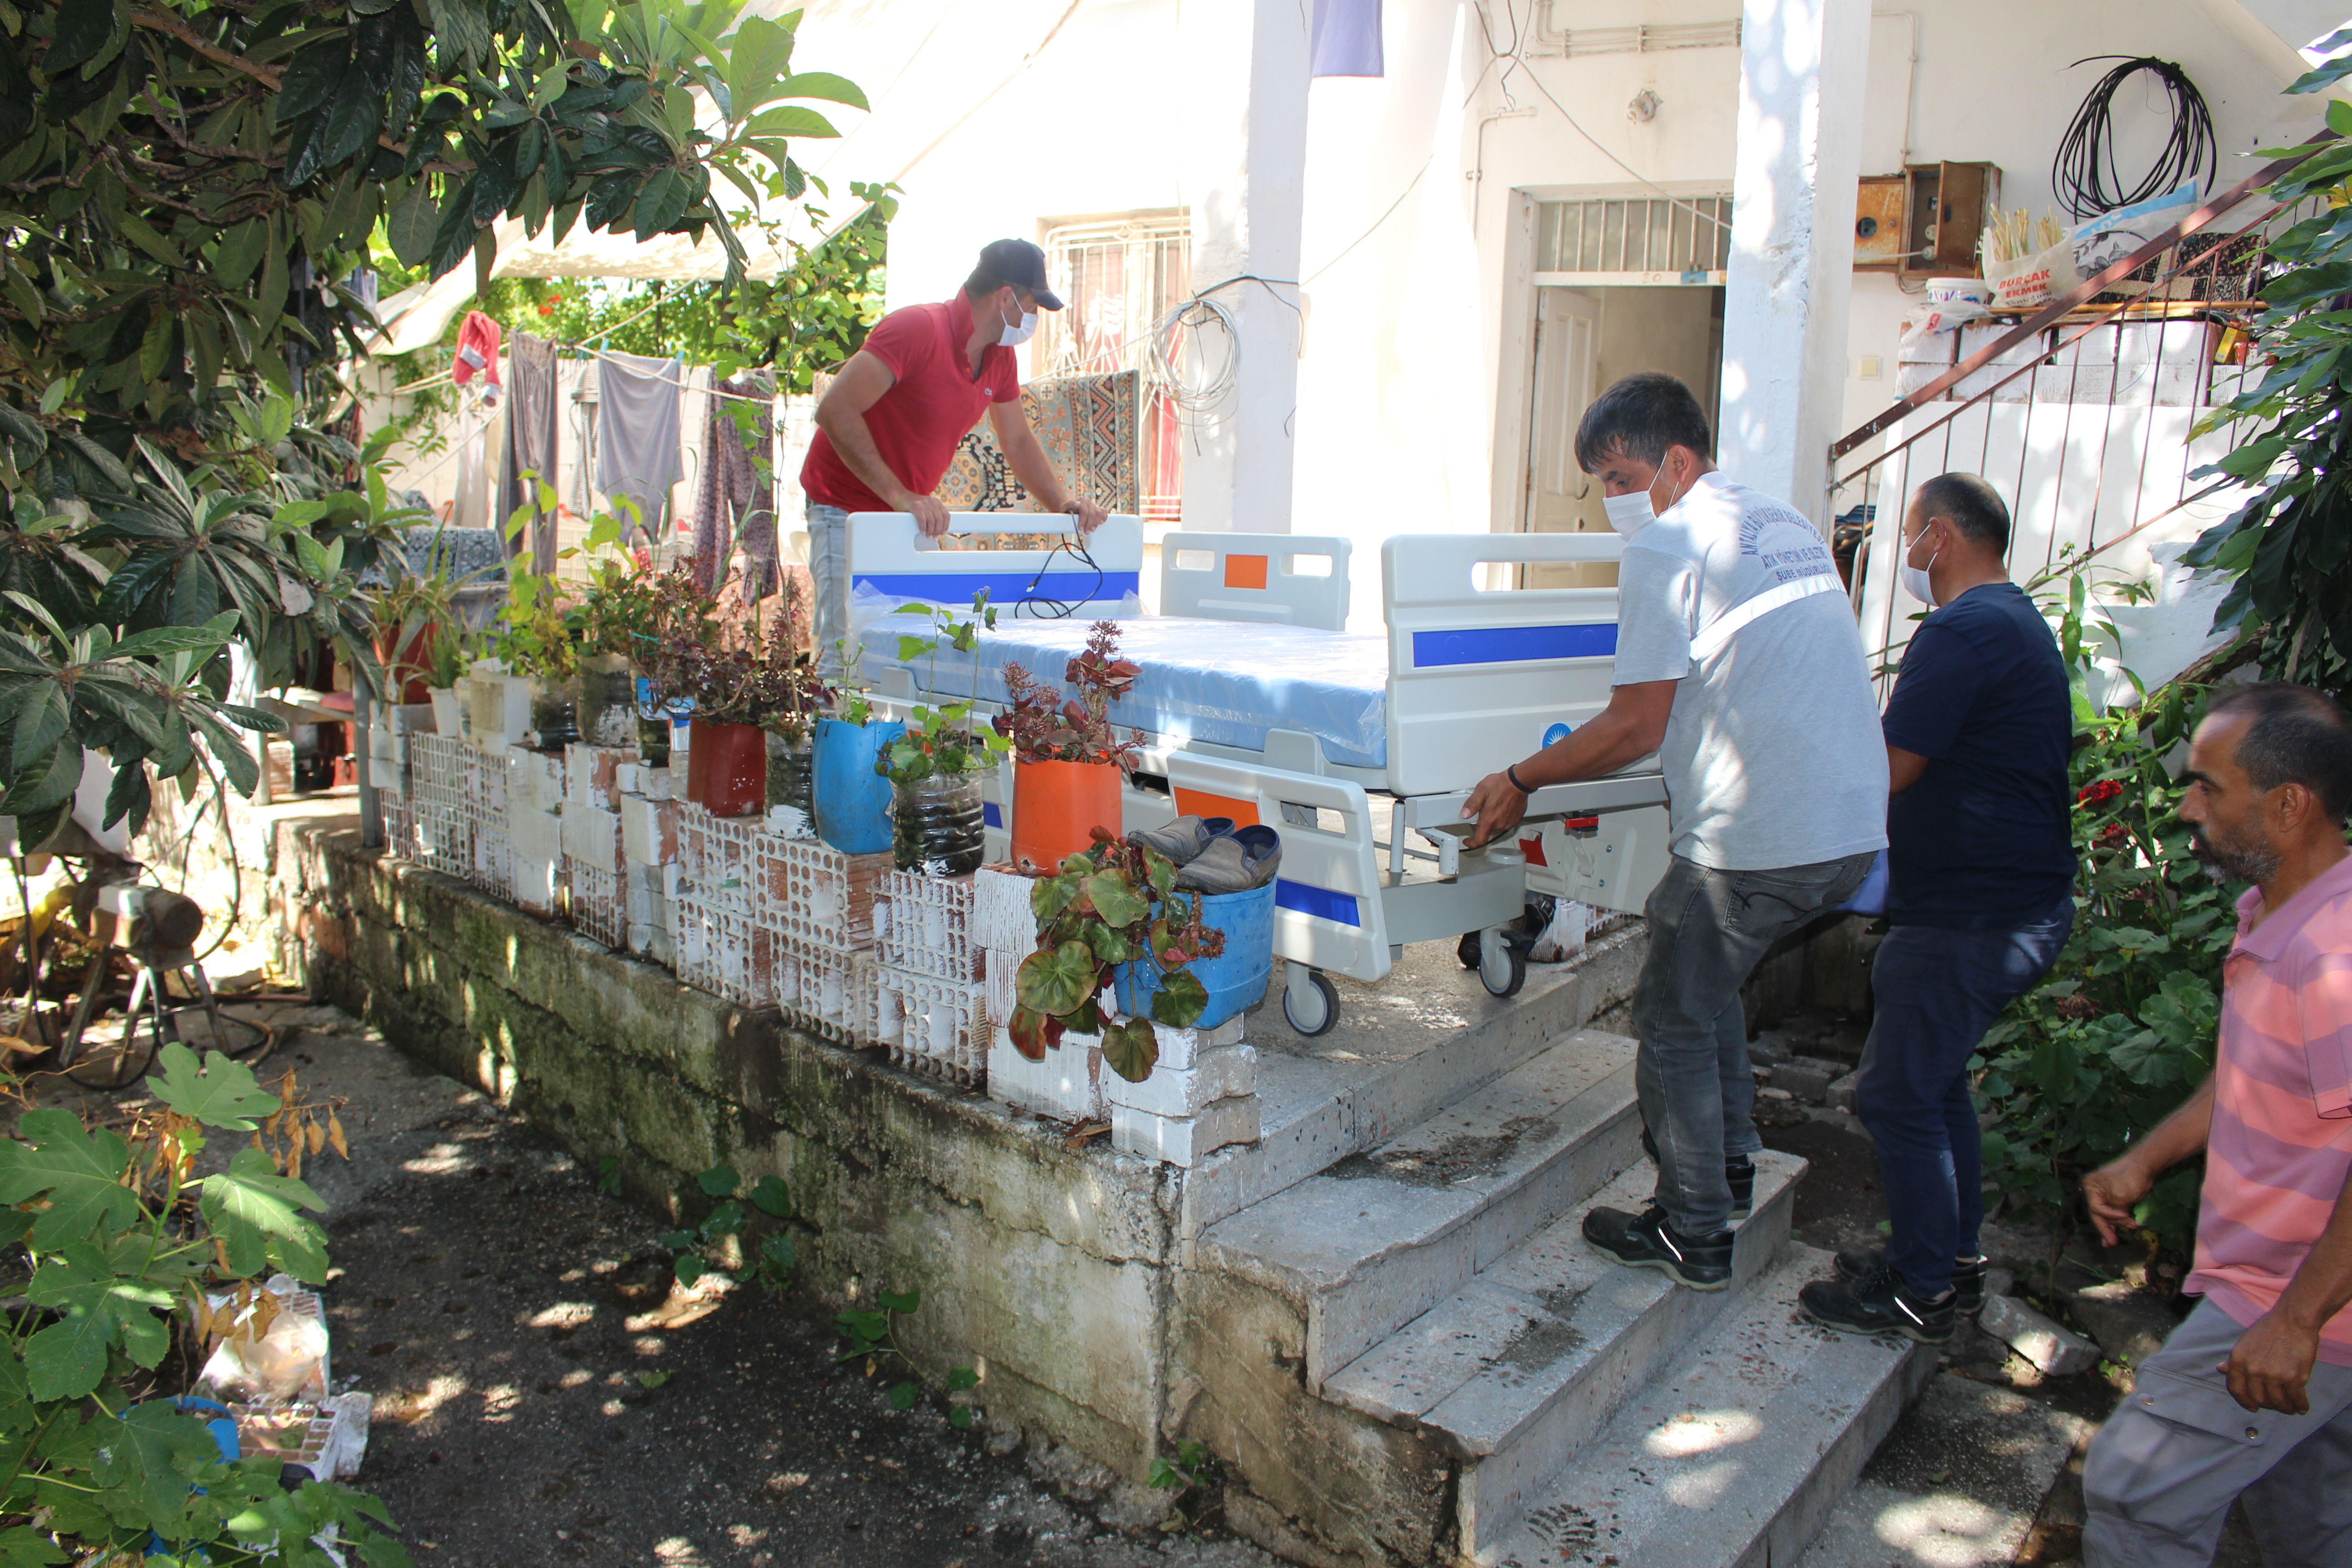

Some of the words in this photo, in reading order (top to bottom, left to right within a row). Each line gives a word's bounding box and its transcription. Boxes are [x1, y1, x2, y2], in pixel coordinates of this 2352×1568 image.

[1999, 269, 2050, 289] BURÇAK
[2006, 283, 2047, 298] EKMEK
[1739, 520, 1760, 555] ANTALYA
[1761, 553, 1779, 569] ATIK
[1798, 548, 1811, 561] VE
[1776, 569, 1797, 583] ŞUBE
